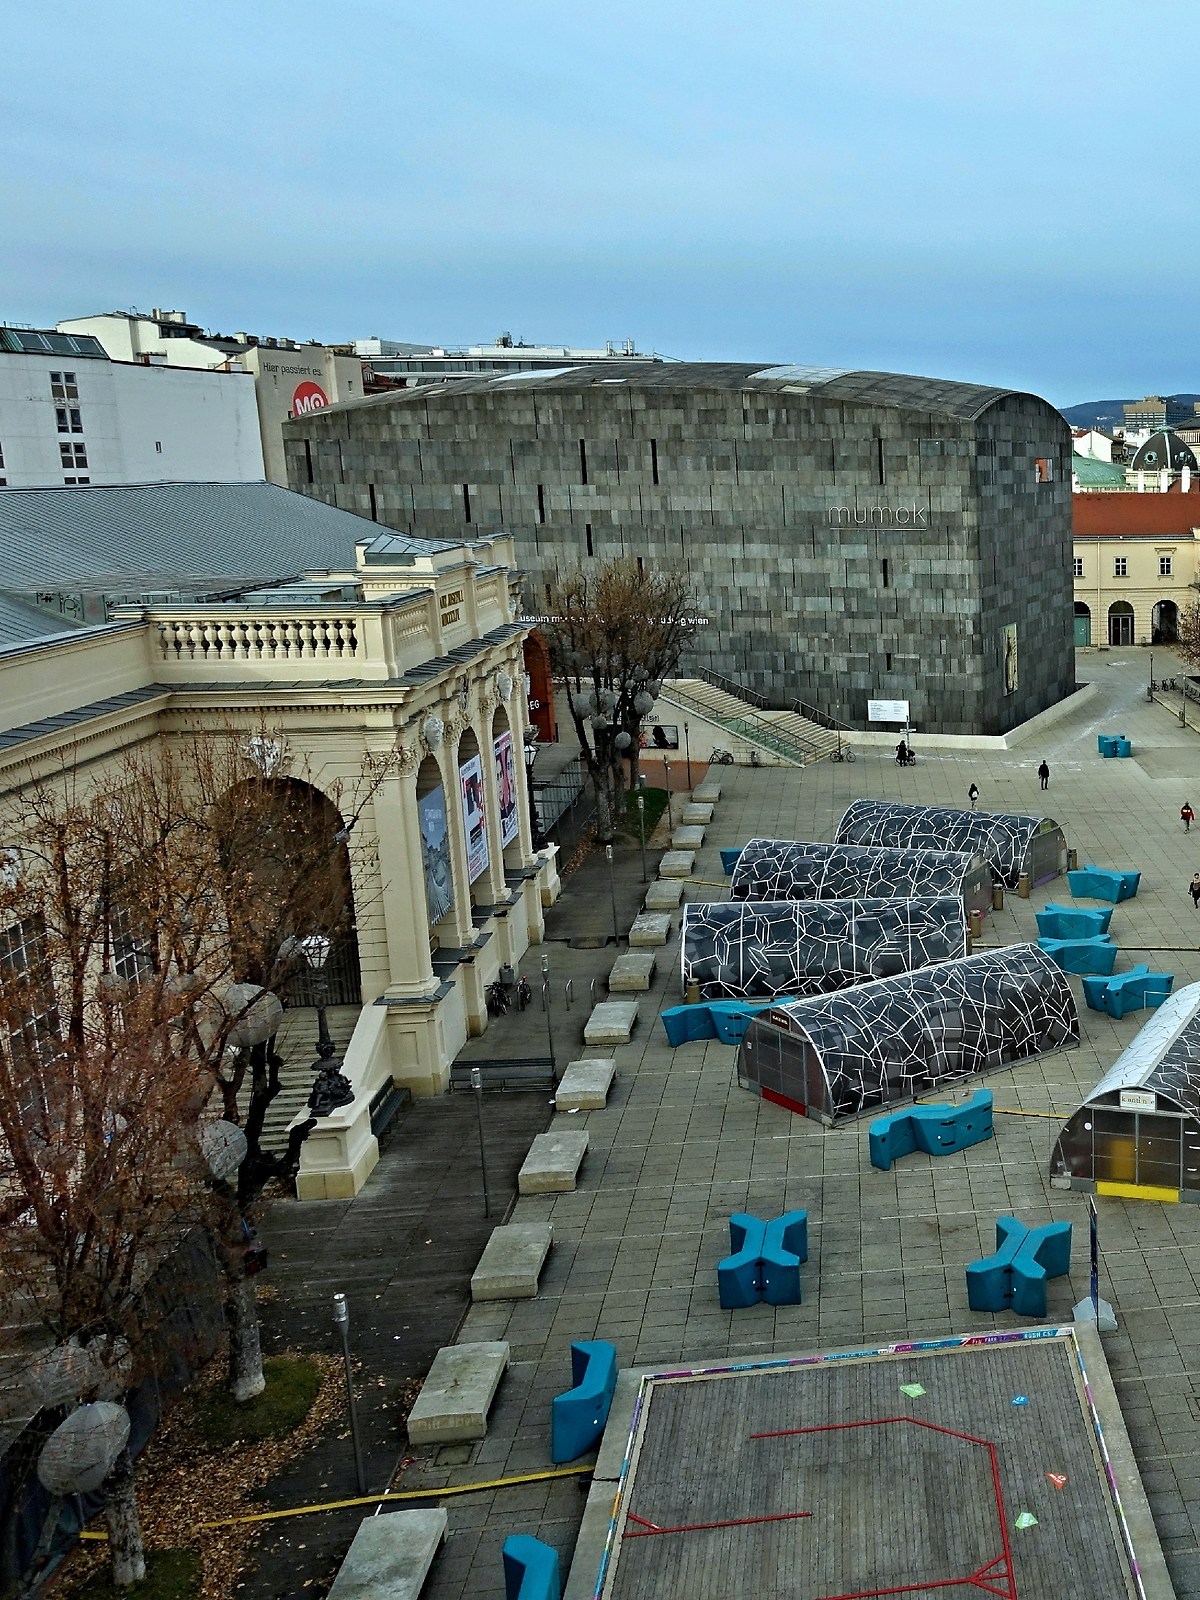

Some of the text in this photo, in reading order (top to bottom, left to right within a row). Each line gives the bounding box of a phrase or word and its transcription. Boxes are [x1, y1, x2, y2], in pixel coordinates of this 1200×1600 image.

[263, 362, 323, 376] Hier passiert es.
[828, 501, 926, 523] mumok
[688, 616, 709, 624] wien
